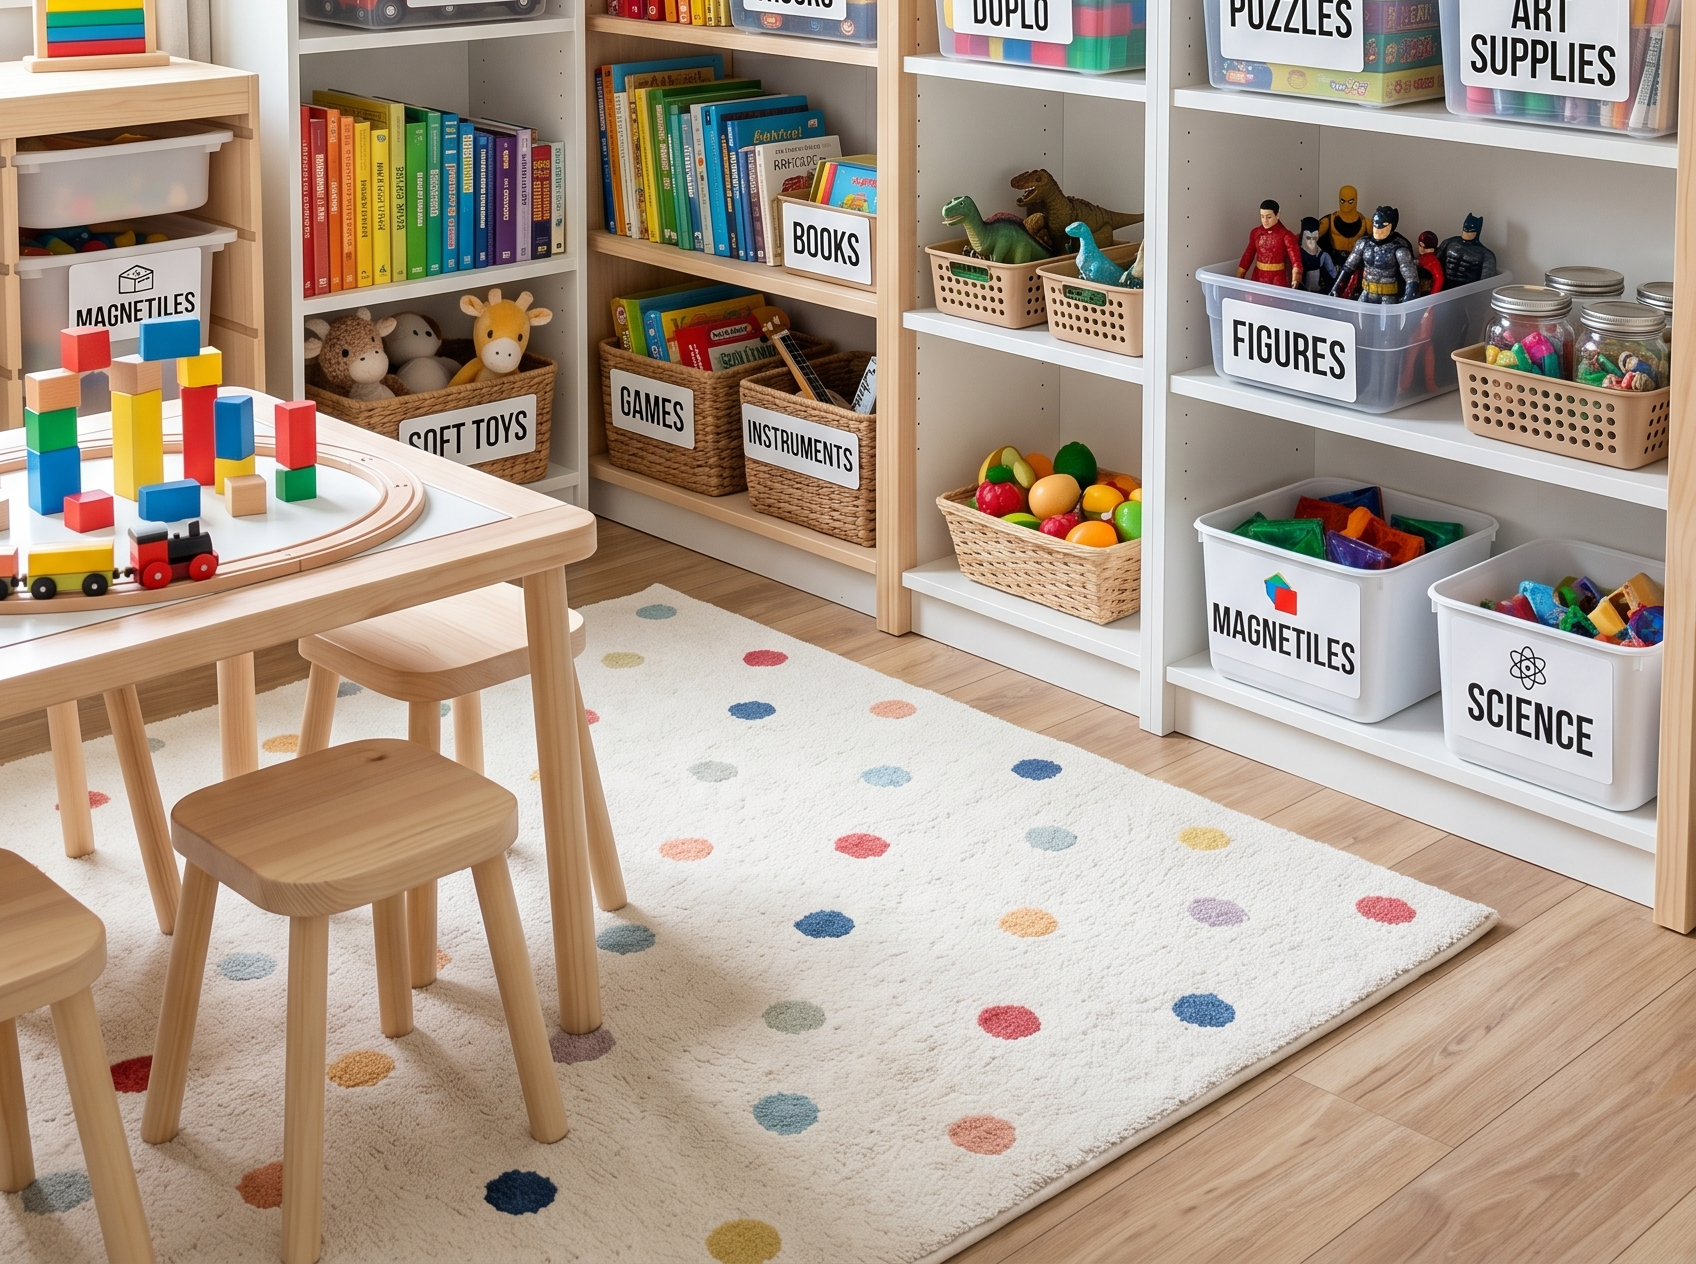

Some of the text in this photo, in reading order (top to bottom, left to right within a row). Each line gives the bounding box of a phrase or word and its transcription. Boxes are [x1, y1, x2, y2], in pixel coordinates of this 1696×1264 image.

[1471, 34, 1615, 86] SUPPLIES
[791, 221, 859, 269] BOOKS
[76, 292, 195, 327] MAGNETILES
[1233, 317, 1348, 382] FIGURES
[472, 410, 527, 449] TOYS
[618, 384, 686, 434] GAMES
[746, 417, 855, 474] INSTRUMENTS
[1214, 600, 1354, 675] MAGNETILES
[1468, 681, 1593, 757] SCIENCE
